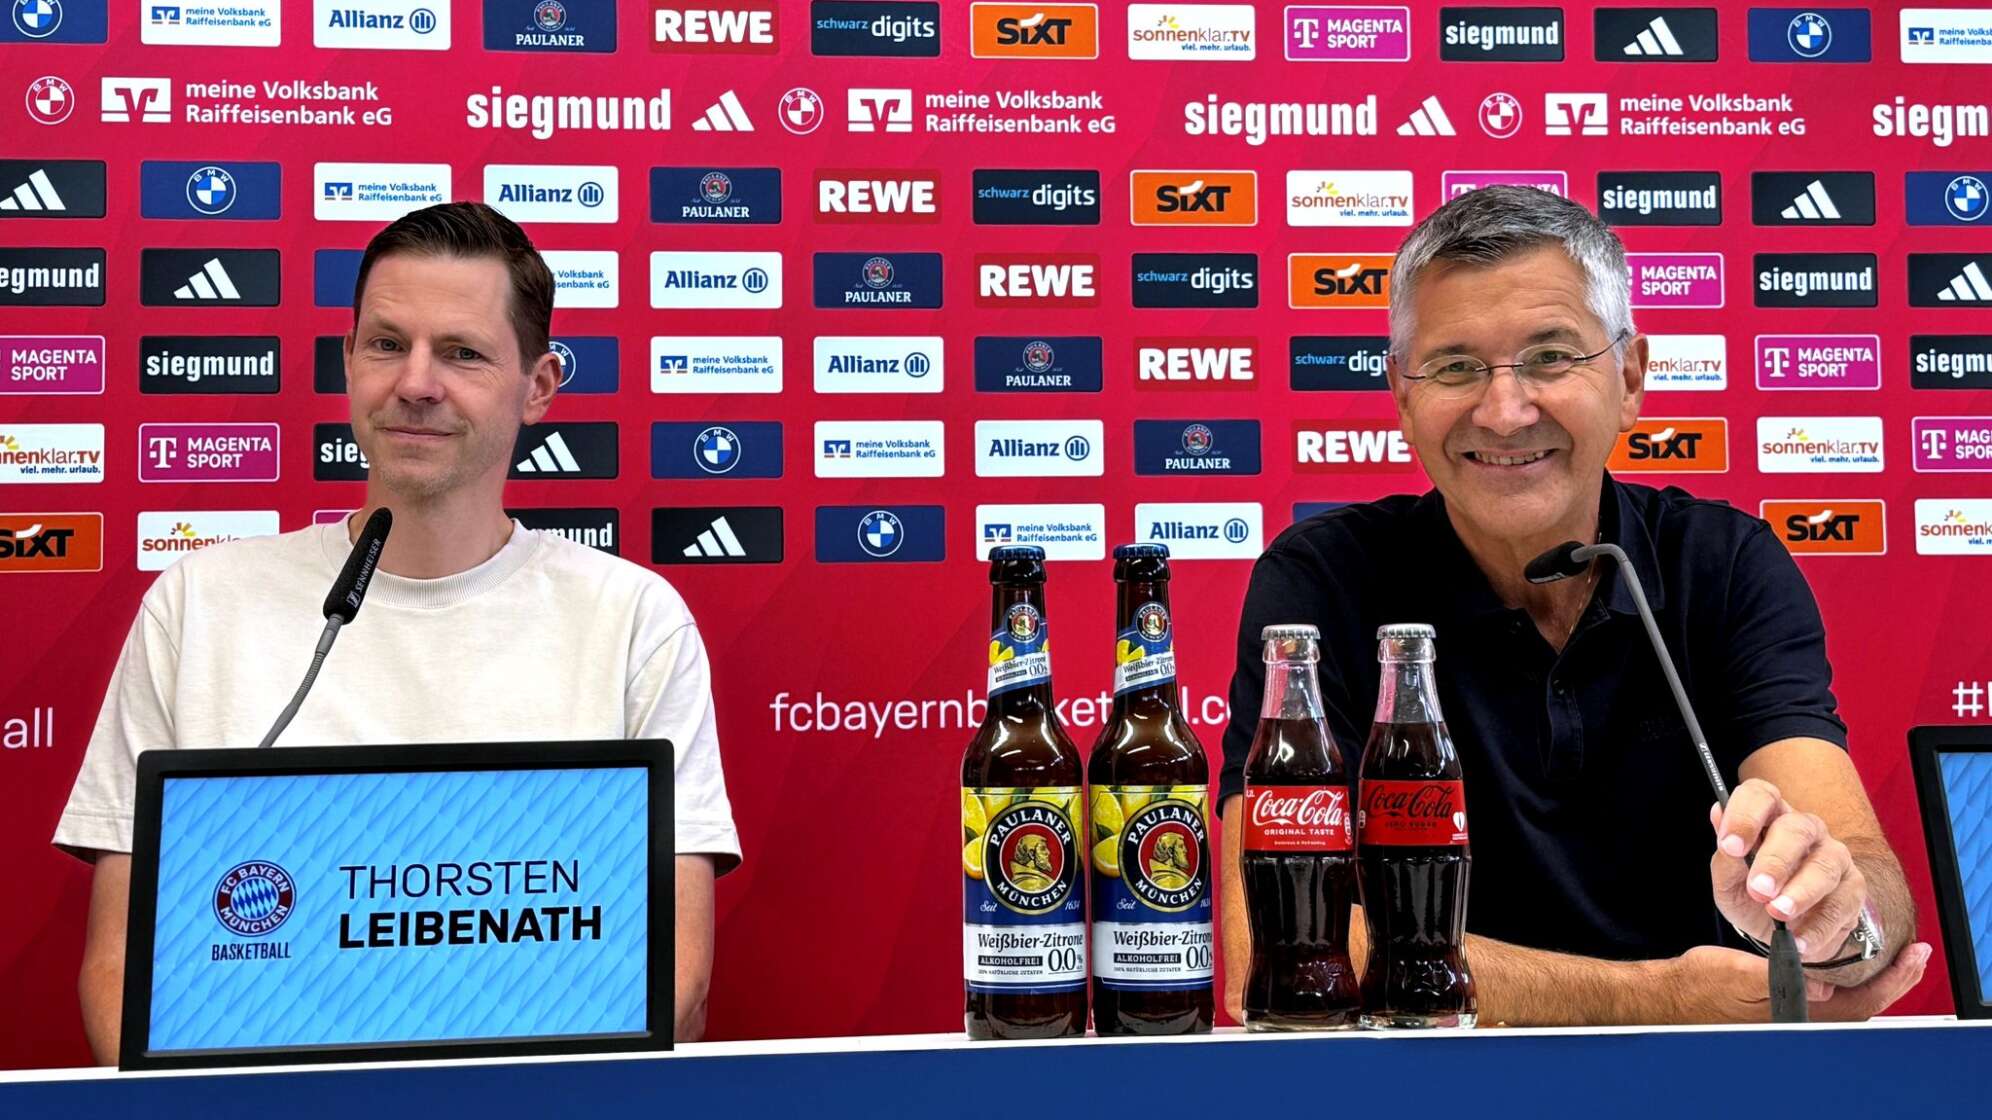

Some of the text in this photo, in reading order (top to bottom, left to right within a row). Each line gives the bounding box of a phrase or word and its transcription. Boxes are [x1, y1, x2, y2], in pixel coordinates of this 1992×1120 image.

[186, 6, 266, 17] meine Volksbank
[329, 10, 404, 28] Allianz
[185, 16, 272, 27] Raiffeisenbank eG
[656, 10, 773, 43] REWE
[816, 16, 934, 42] schwarz digits
[1327, 18, 1403, 33] MAGENTA
[515, 34, 584, 47] PAULANER
[1328, 34, 1377, 49] SPORT
[1446, 21, 1558, 50] siegmund
[32, 79, 70, 93] BMW
[187, 80, 378, 100] meine Volksbank
[926, 91, 1102, 108] meine Volksbank
[1620, 94, 1792, 112] meine Volksbank
[187, 104, 391, 125] Raiffeisenbank eG
[467, 86, 670, 139] siegmund
[1185, 94, 1376, 145] siegmund
[927, 114, 1115, 133] Raiffeisenbank eG
[1621, 117, 1805, 135] Raiffeisenbank eG
[358, 183, 437, 193] meine Volksbank
[499, 184, 572, 202] Allianz
[820, 181, 935, 212] REWE
[358, 192, 443, 202] Raiffeisenbank eG
[978, 184, 1095, 210] schwarz digits
[1603, 185, 1716, 214] siegmund
[682, 205, 750, 219] PAULANER
[557, 270, 604, 279] Volksbank
[665, 271, 737, 288] Allianz
[980, 265, 1095, 296] REWE
[1137, 268, 1253, 293] schwarz digits
[1641, 266, 1717, 280] MAGENTA
[1760, 267, 1872, 296] siegmund
[597, 280, 610, 289] eG
[1641, 281, 1691, 295] SPORT
[845, 291, 911, 304] PAULANER
[11, 349, 97, 364] MAGENTA
[693, 355, 769, 364] meine Volksbank
[1295, 350, 1388, 377] schwarz digi
[1798, 348, 1873, 362] MAGENTA
[147, 351, 273, 381] siegmund
[693, 365, 774, 375] Raiffeisenbank eG
[828, 356, 899, 373] Allianz
[1140, 348, 1253, 380] REWE
[1649, 359, 1722, 373] enklar.TV
[1798, 363, 1848, 377] SPORT
[11, 366, 67, 381] SPORT
[1006, 374, 1071, 387] PAULANER
[187, 438, 272, 453] MAGENTA
[856, 440, 930, 449] meine Volksbank
[989, 439, 1059, 456] Allianz
[1298, 431, 1411, 462] REWE
[187, 453, 242, 469] SPORT
[856, 449, 936, 459] Raiffeisenbank eG
[1165, 457, 1231, 470] PAULANER
[1017, 523, 1092, 533] meine Volksbank
[1150, 522, 1219, 539] Allianz
[1017, 533, 1098, 543] Raiffeisenbank eG
[355, 538, 381, 591] SENNHEISER
[1252, 789, 1344, 826] Coca-Cola
[990, 808, 1071, 847] PAULANER
[1127, 807, 1206, 845] PAULANER
[220, 865, 290, 895] FC BAYERN
[340, 861, 578, 898] THORSTEN
[997, 880, 1068, 907] MÜNCHEN
[1135, 878, 1203, 905] MÜNCHEN
[339, 906, 601, 948] LEIBENATH
[1113, 929, 1212, 950] Weißbier-Zitron
[212, 942, 290, 961] BASKETBALL
[1114, 954, 1179, 963] ALKOHOLFREI
[979, 956, 1040, 966] ALKOHOLFREI
